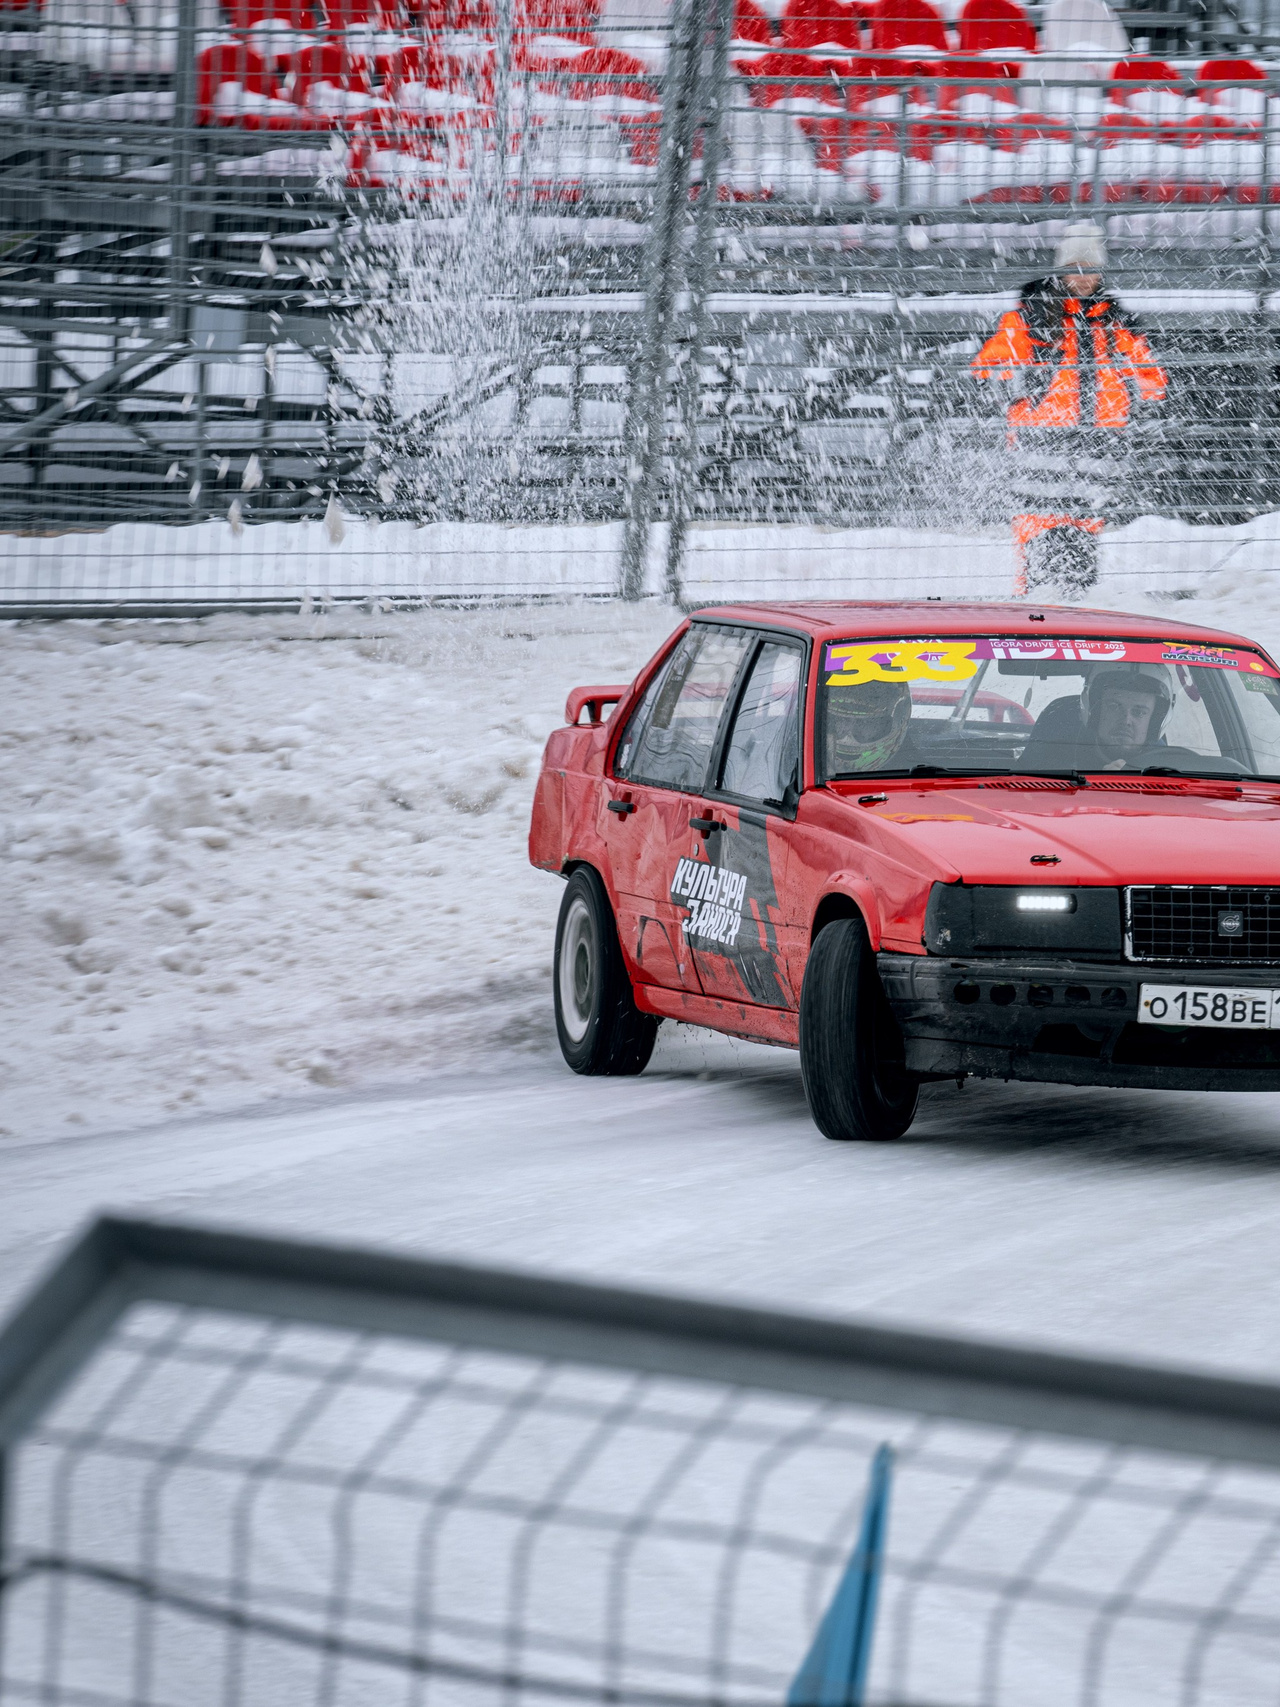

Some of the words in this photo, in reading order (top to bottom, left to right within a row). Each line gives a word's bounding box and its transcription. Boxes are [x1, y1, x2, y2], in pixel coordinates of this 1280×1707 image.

[825, 642, 979, 687] 333
[1161, 652, 1239, 667] MATSURI
[670, 858, 748, 912] КУЛЬТУРА
[681, 898, 742, 947] ЗАНОСА
